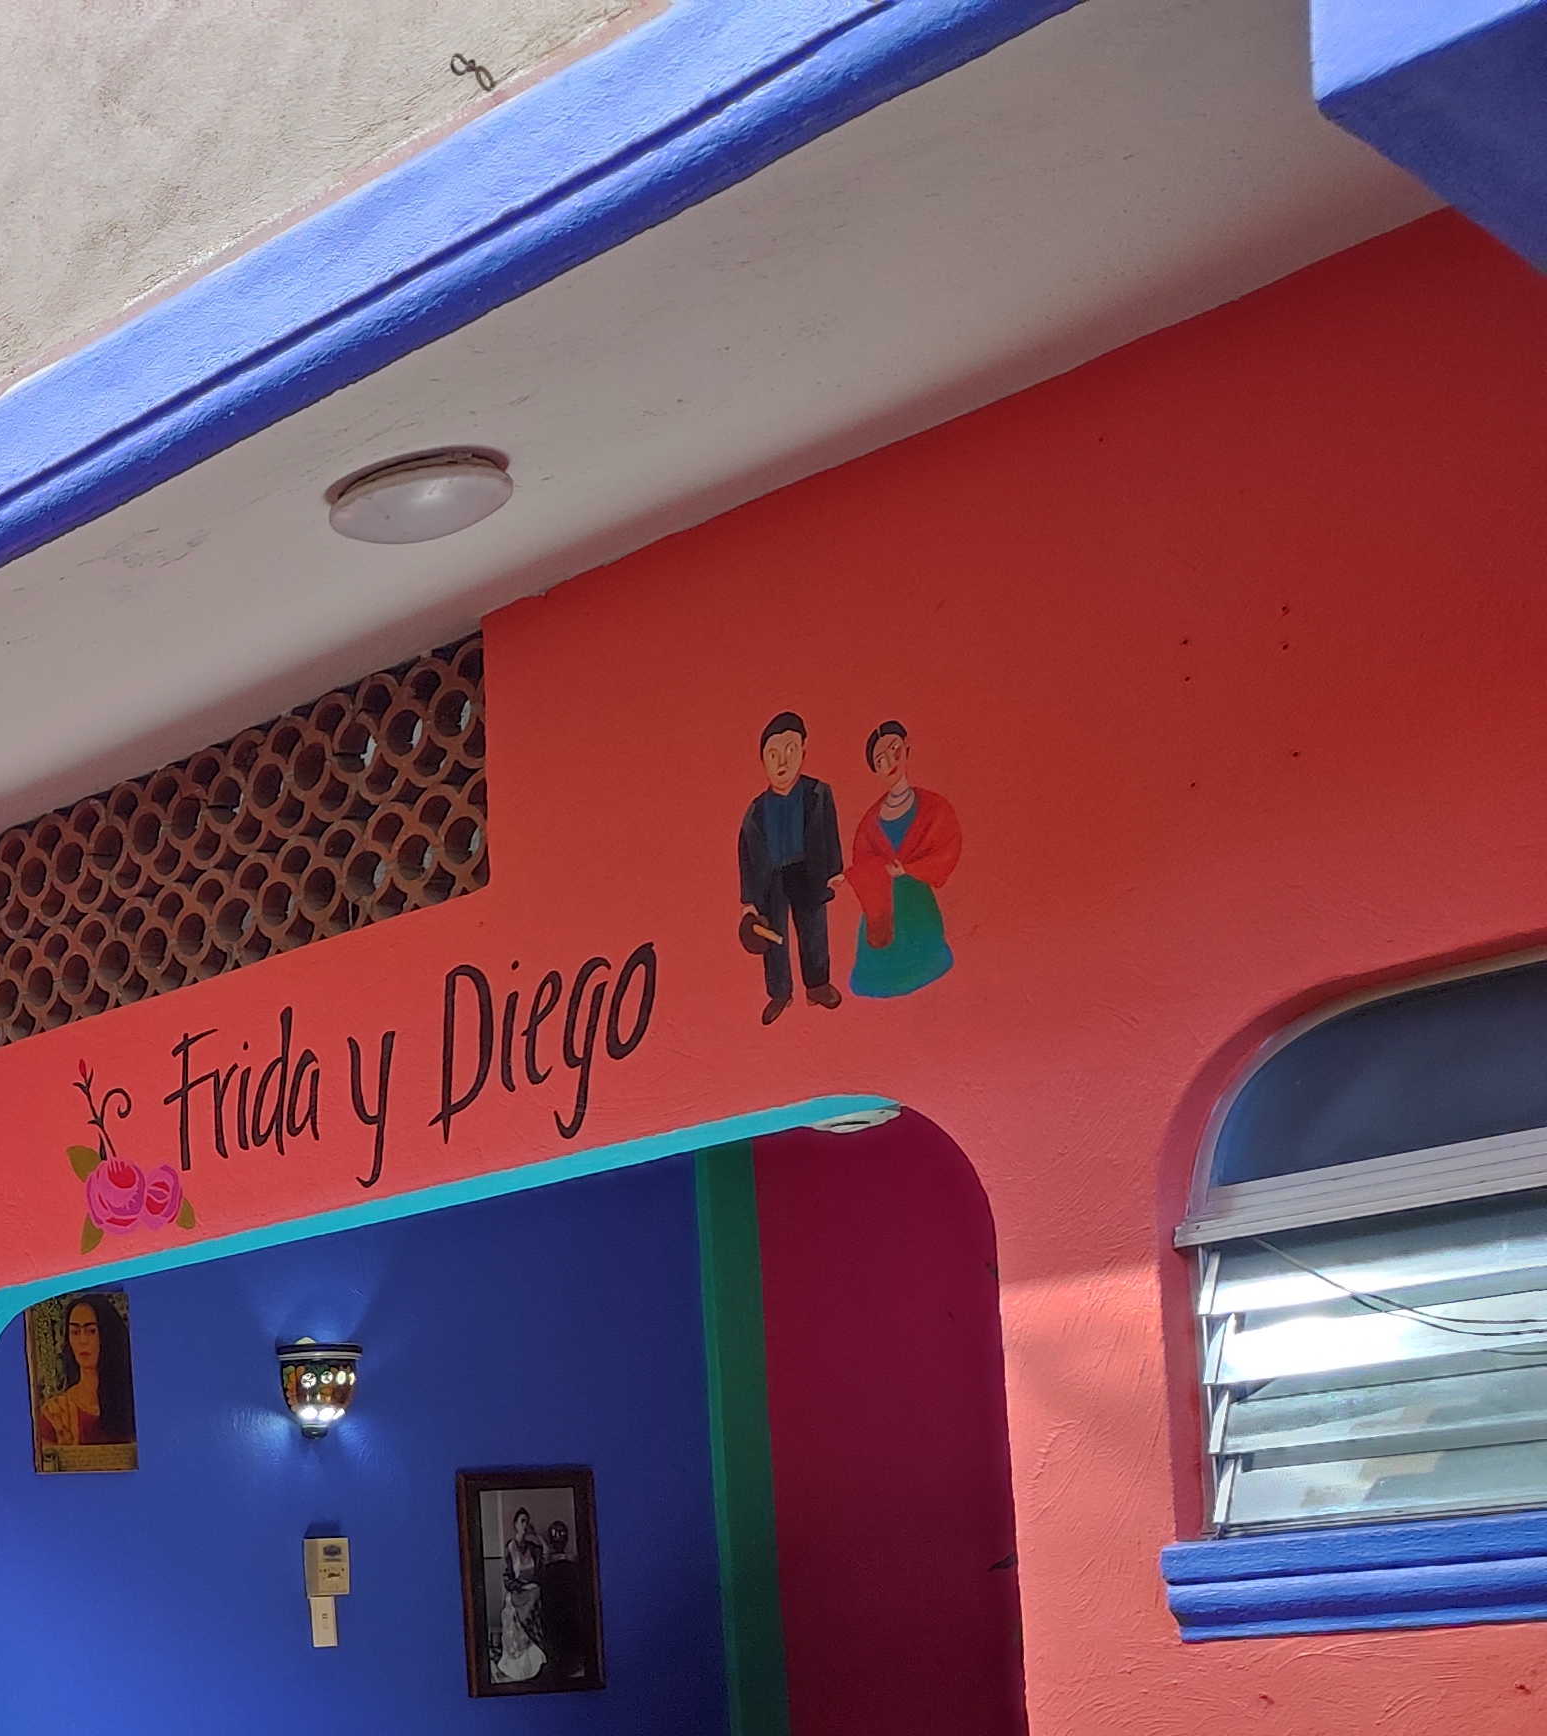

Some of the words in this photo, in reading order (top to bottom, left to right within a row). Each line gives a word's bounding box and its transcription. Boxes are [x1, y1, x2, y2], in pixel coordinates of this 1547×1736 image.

[163, 1005, 320, 1171] Frida
[347, 1030, 396, 1188] y
[429, 941, 657, 1144] Diego
